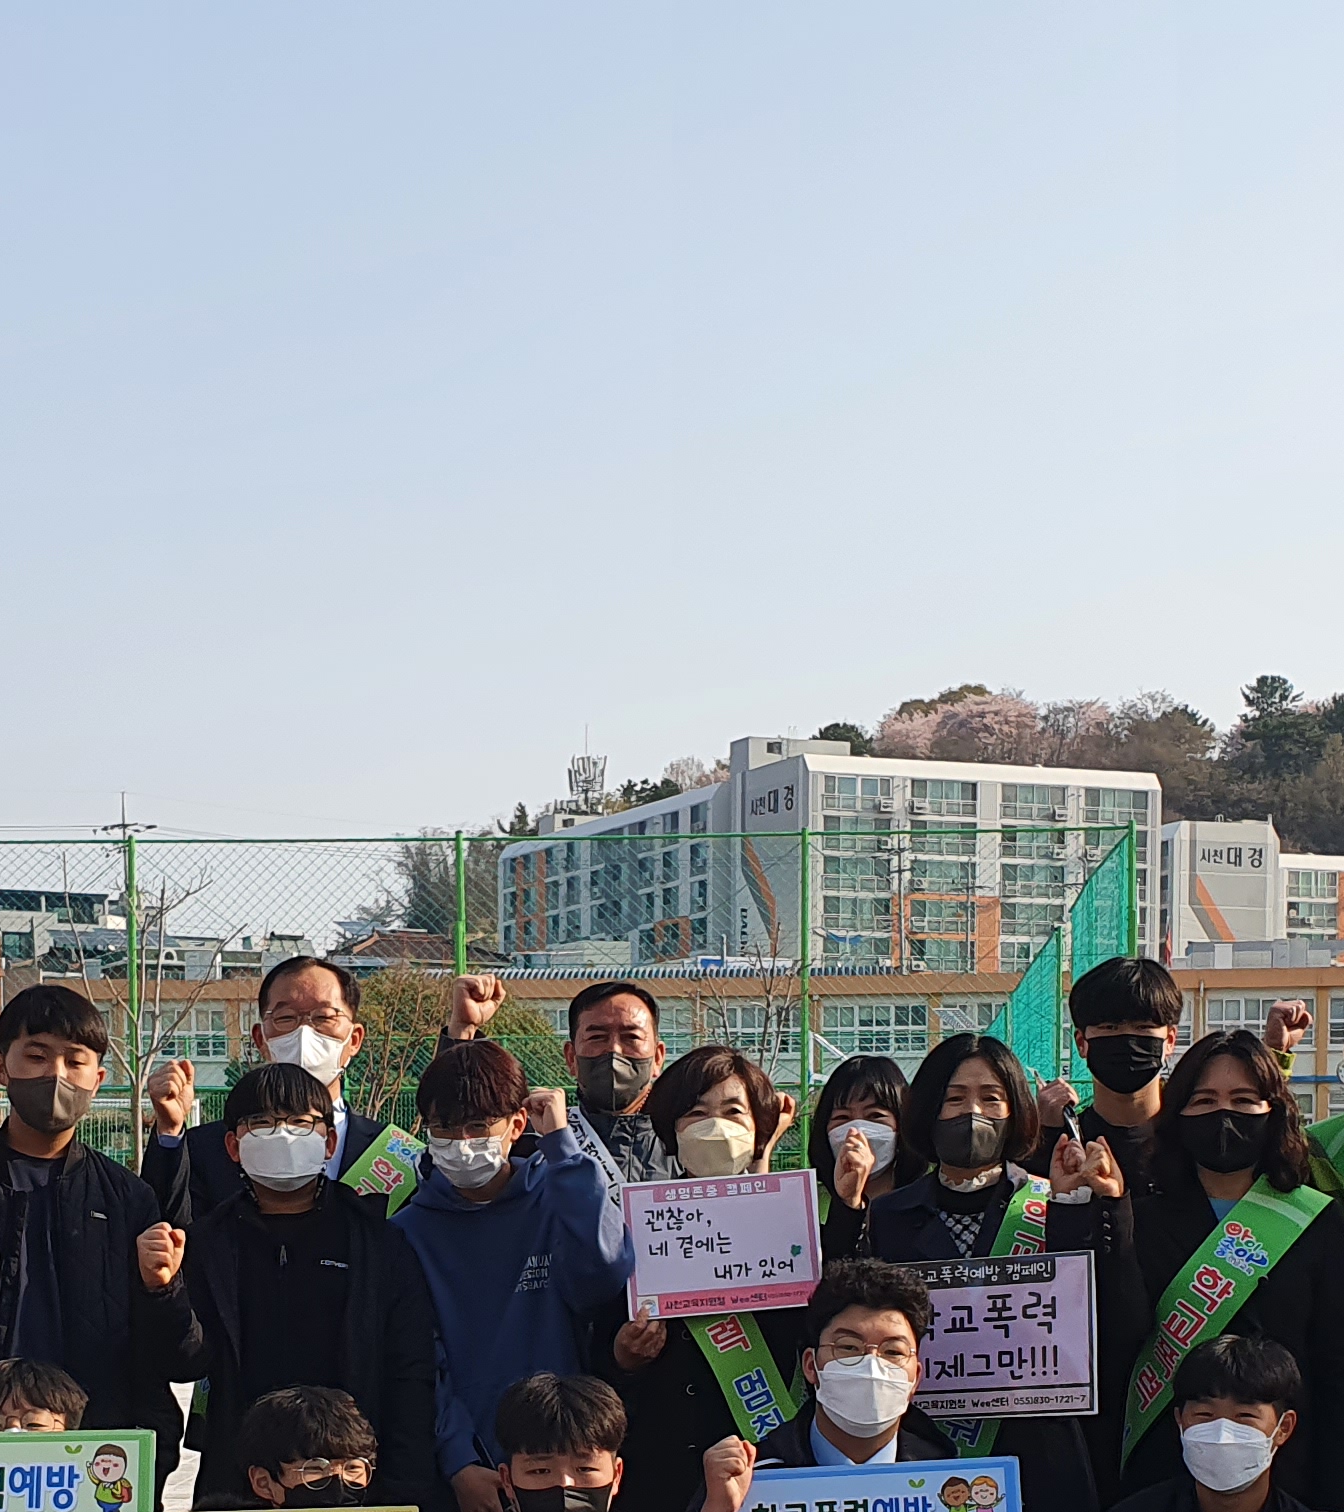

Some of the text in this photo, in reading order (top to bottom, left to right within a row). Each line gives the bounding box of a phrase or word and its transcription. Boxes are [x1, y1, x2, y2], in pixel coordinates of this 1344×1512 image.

[649, 1232, 732, 1259] 네 곁에는
[714, 1257, 795, 1280] 내가 있어
[1006, 1260, 1052, 1281] 캠페인
